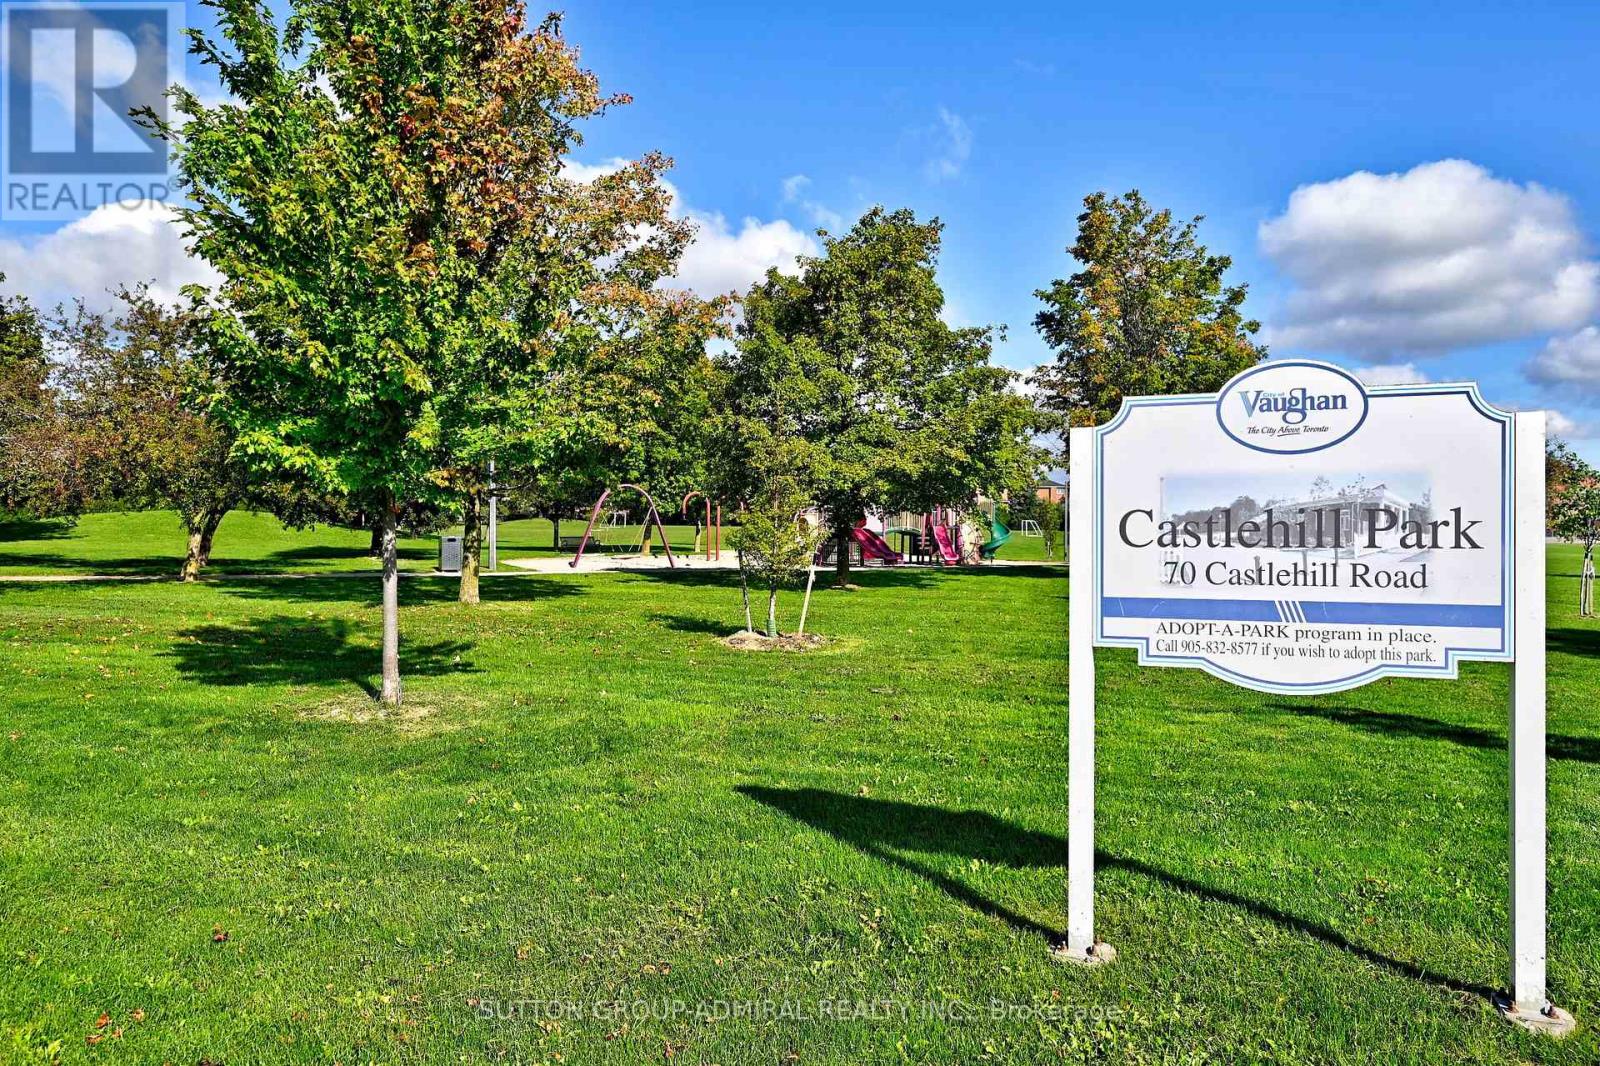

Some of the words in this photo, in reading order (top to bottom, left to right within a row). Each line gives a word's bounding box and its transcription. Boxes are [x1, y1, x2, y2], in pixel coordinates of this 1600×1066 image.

[1237, 388, 1348, 425] Vaughan
[1247, 426, 1260, 435] The
[1261, 426, 1277, 437] City
[1277, 426, 1301, 435] Above
[1302, 425, 1329, 433] Toronto
[1118, 508, 1346, 550] Castlehill
[1362, 507, 1485, 551] Park
[1163, 561, 1197, 586] 70
[1204, 561, 1339, 588] Castlehill
[1349, 563, 1429, 589] Road
[1156, 621, 1290, 639] ADOPT-A-PARK
[1295, 628, 1362, 644] program
[1367, 627, 1382, 641] in
[1388, 628, 1437, 645] place.
[1156, 639, 1178, 653] Call
[1181, 640, 1258, 656] 905-832-8577
[1261, 642, 1272, 656] if
[1273, 645, 1295, 660] you
[1298, 644, 1325, 659] wish
[1329, 647, 1341, 659] to
[1343, 646, 1377, 663] adopt
[1380, 647, 1402, 661] this
[1405, 648, 1437, 665] park.
